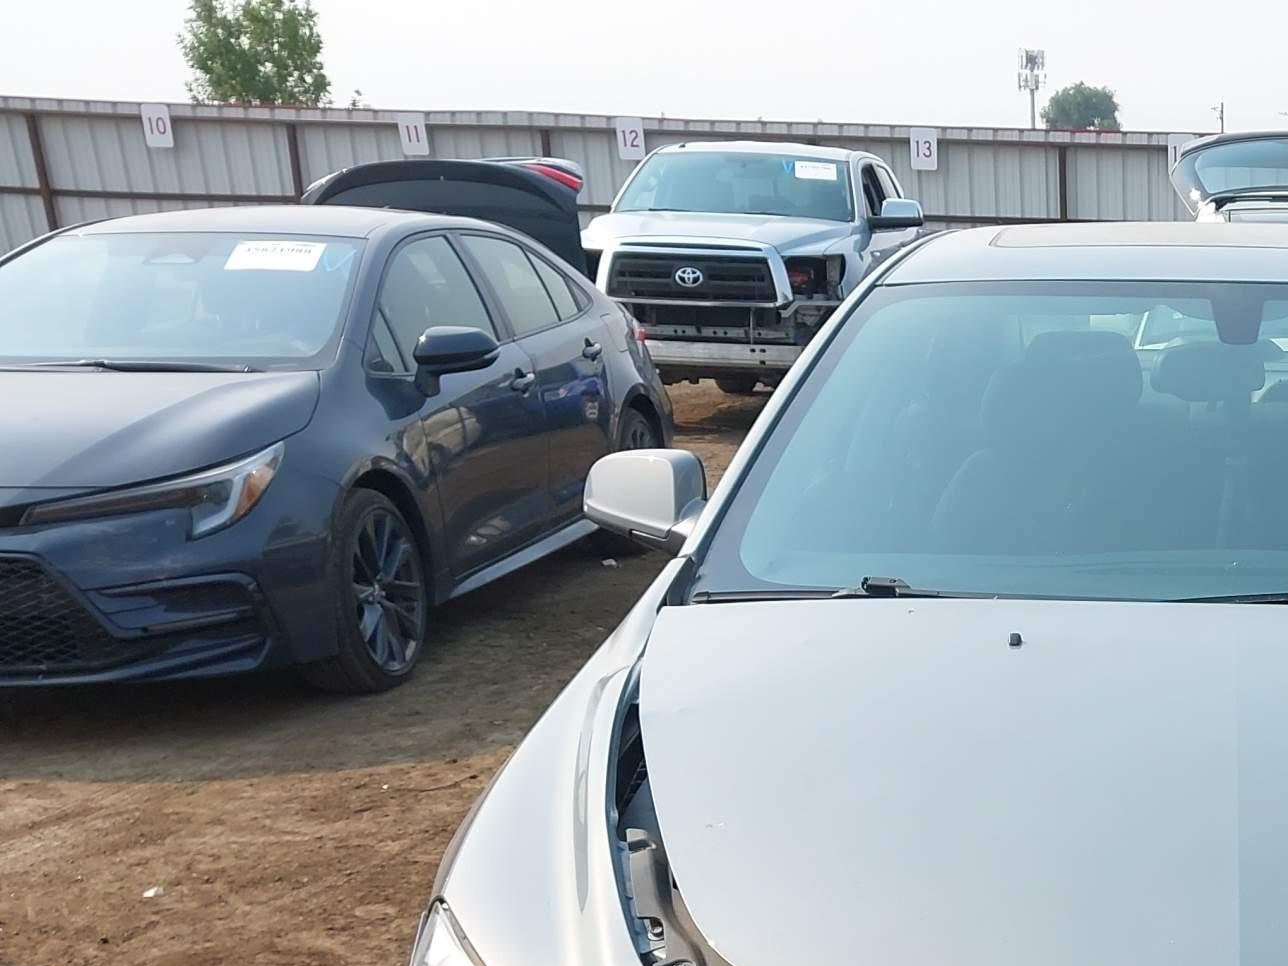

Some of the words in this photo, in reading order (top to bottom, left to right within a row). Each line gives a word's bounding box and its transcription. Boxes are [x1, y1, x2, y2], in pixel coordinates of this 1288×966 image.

[148, 116, 167, 135] 10
[405, 124, 420, 143] 11
[622, 129, 640, 147] 12
[915, 140, 932, 158] 13
